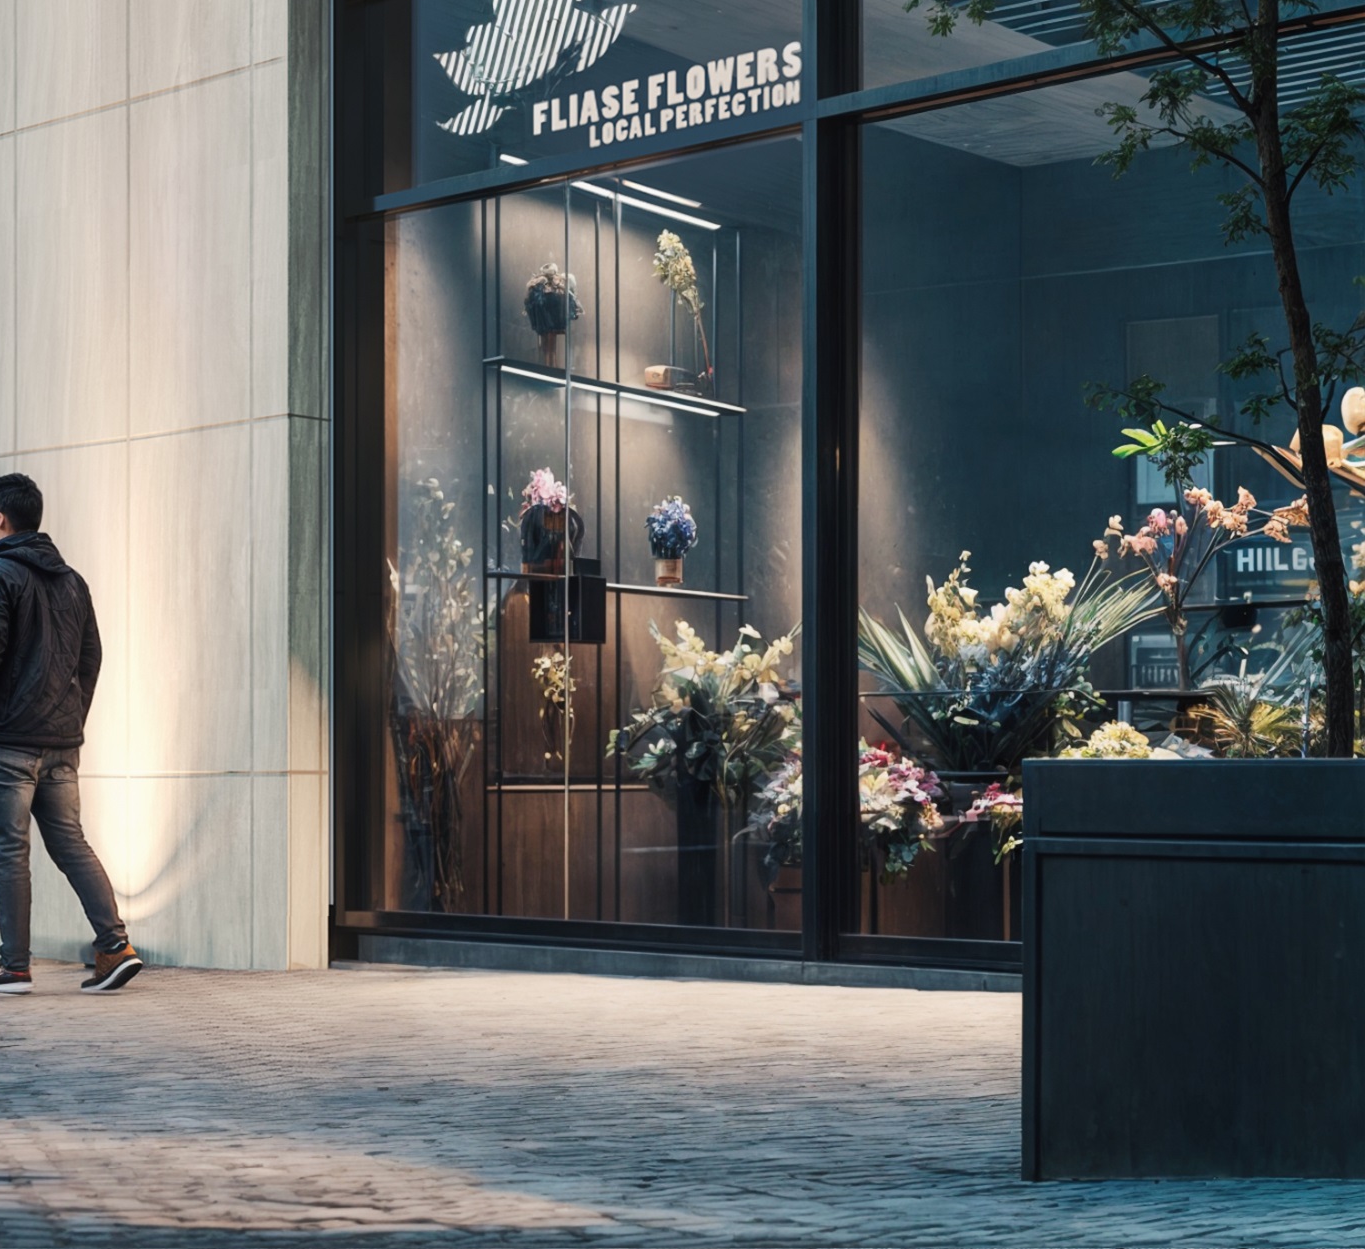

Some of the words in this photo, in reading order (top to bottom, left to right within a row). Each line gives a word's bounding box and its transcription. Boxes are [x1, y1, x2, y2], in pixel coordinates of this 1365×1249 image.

[532, 80, 639, 136] FLIASE
[647, 41, 802, 112] FLOWERS
[589, 113, 656, 149] LOCAL
[660, 79, 801, 133] PERFECTION
